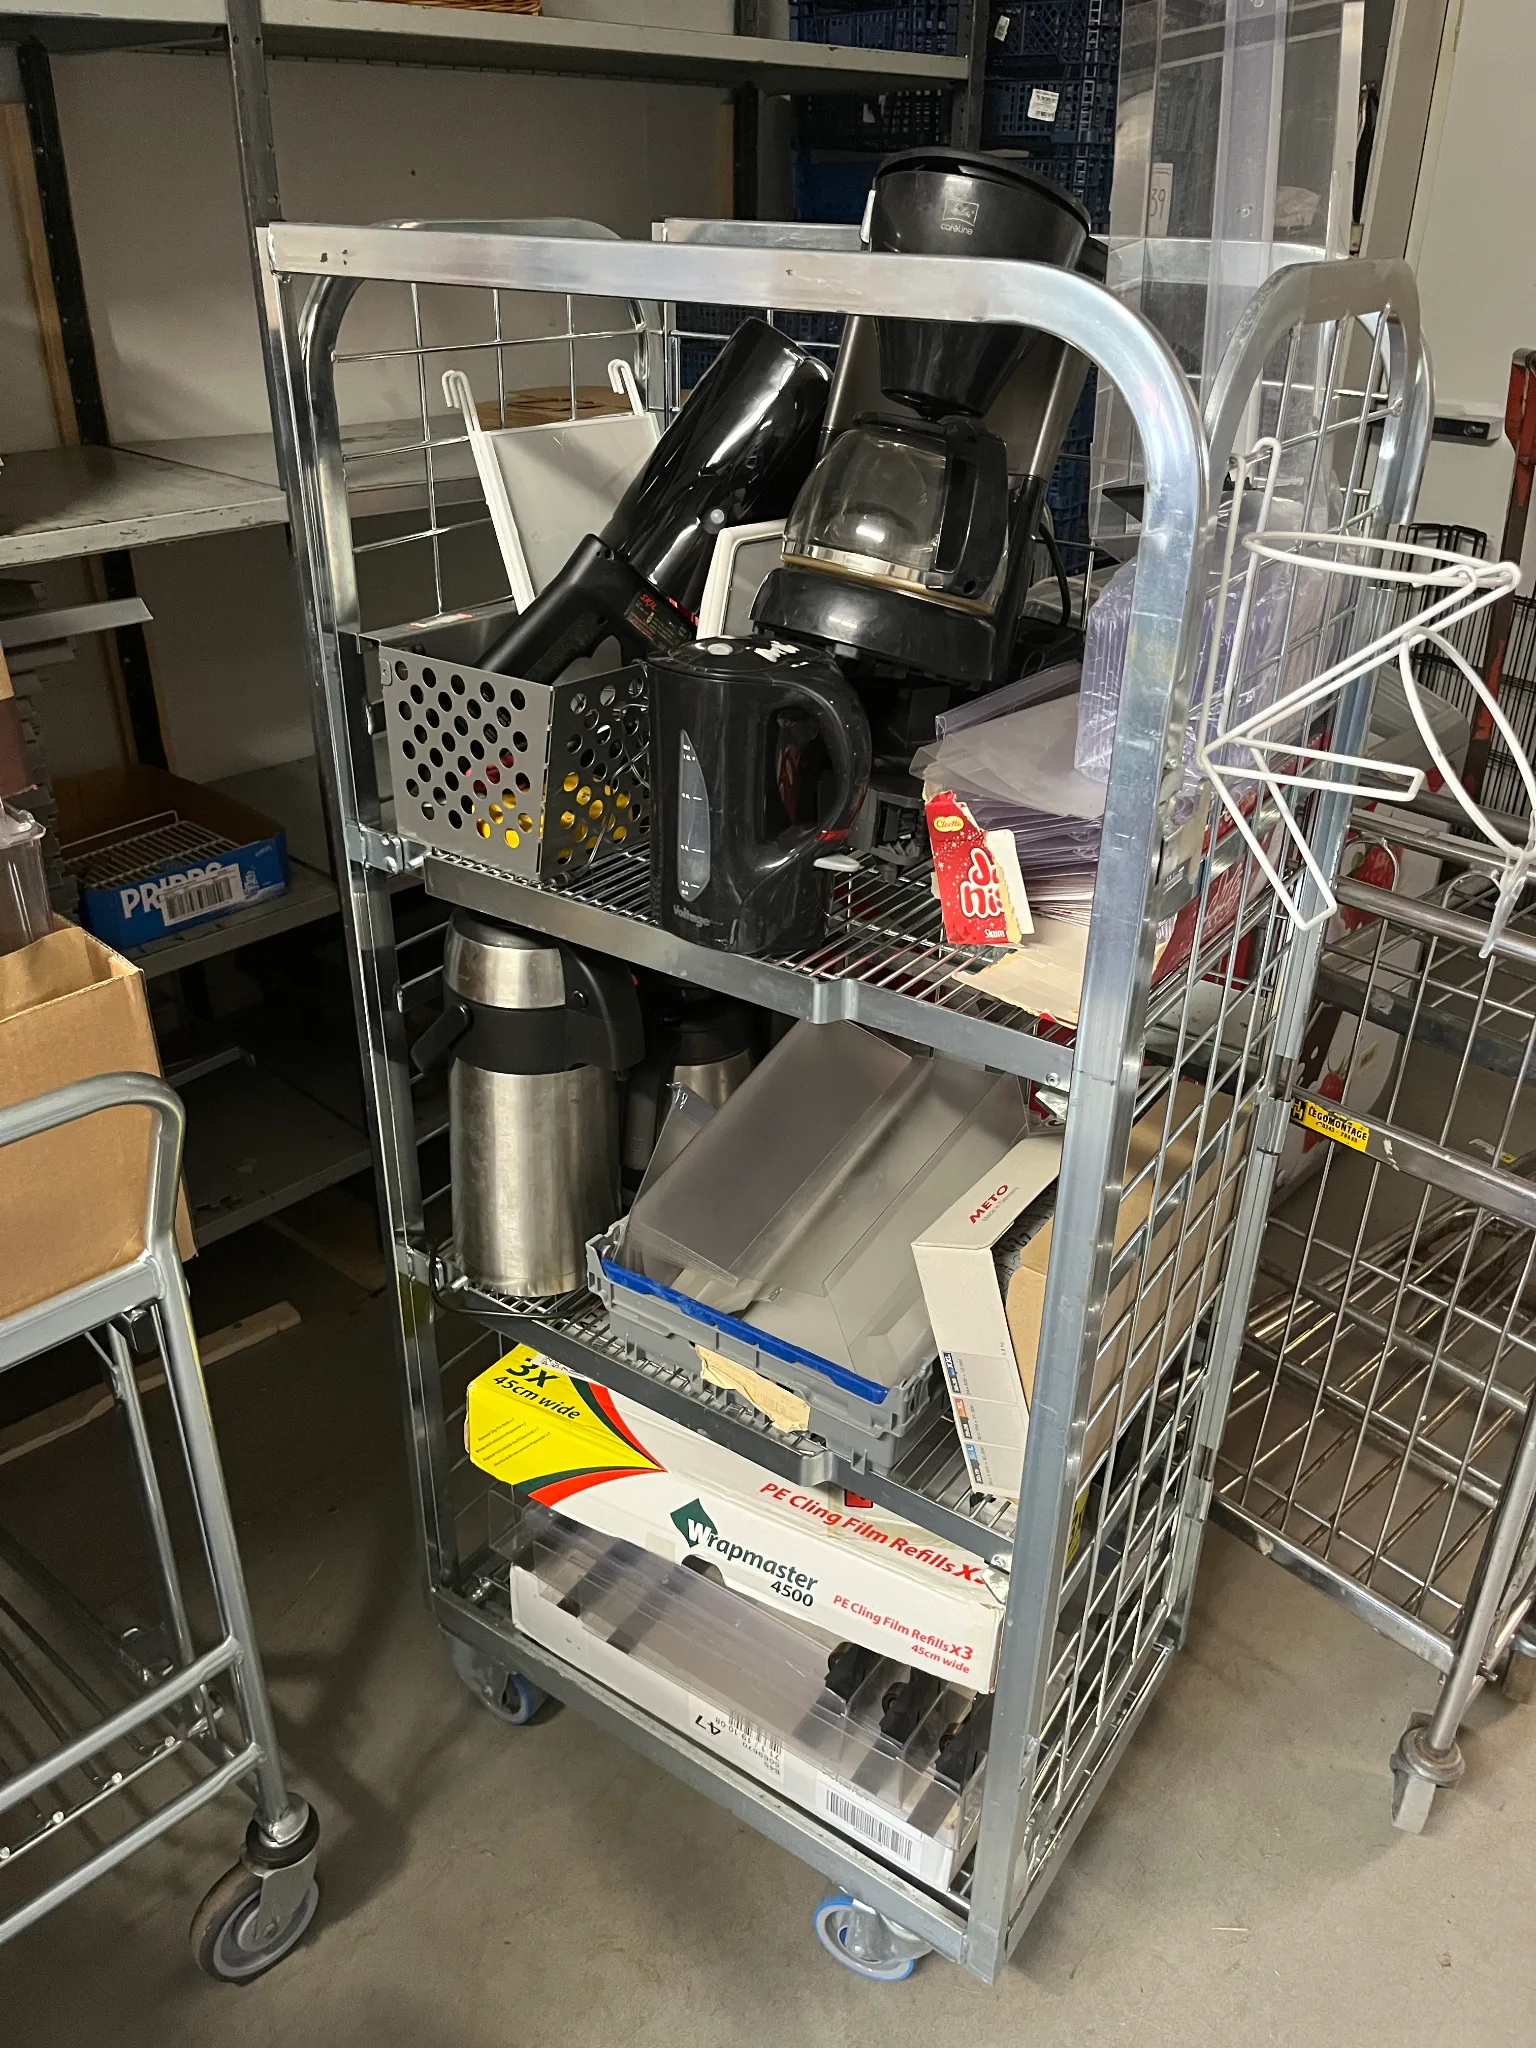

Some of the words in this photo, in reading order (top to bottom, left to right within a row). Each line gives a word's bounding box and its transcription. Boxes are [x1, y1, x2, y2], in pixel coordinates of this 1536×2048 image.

[673, 904, 711, 928] Voltage
[969, 1184, 1008, 1224] METO
[493, 1376, 538, 1402] 45cm
[539, 1397, 581, 1420] wide
[759, 1482, 792, 1501] PE
[789, 1494, 843, 1526] Cling
[841, 1516, 889, 1544] Film
[888, 1536, 956, 1573] Refills
[687, 1518, 818, 1591] Wrapmaster
[770, 1580, 814, 1607] 4500
[833, 1594, 850, 1609] PE
[850, 1602, 882, 1625] Cling
[882, 1616, 910, 1636] Film
[911, 1628, 950, 1652] Refills
[911, 1644, 941, 1663] 45cm
[942, 1656, 970, 1674] wide
[695, 1714, 721, 1735] 47
